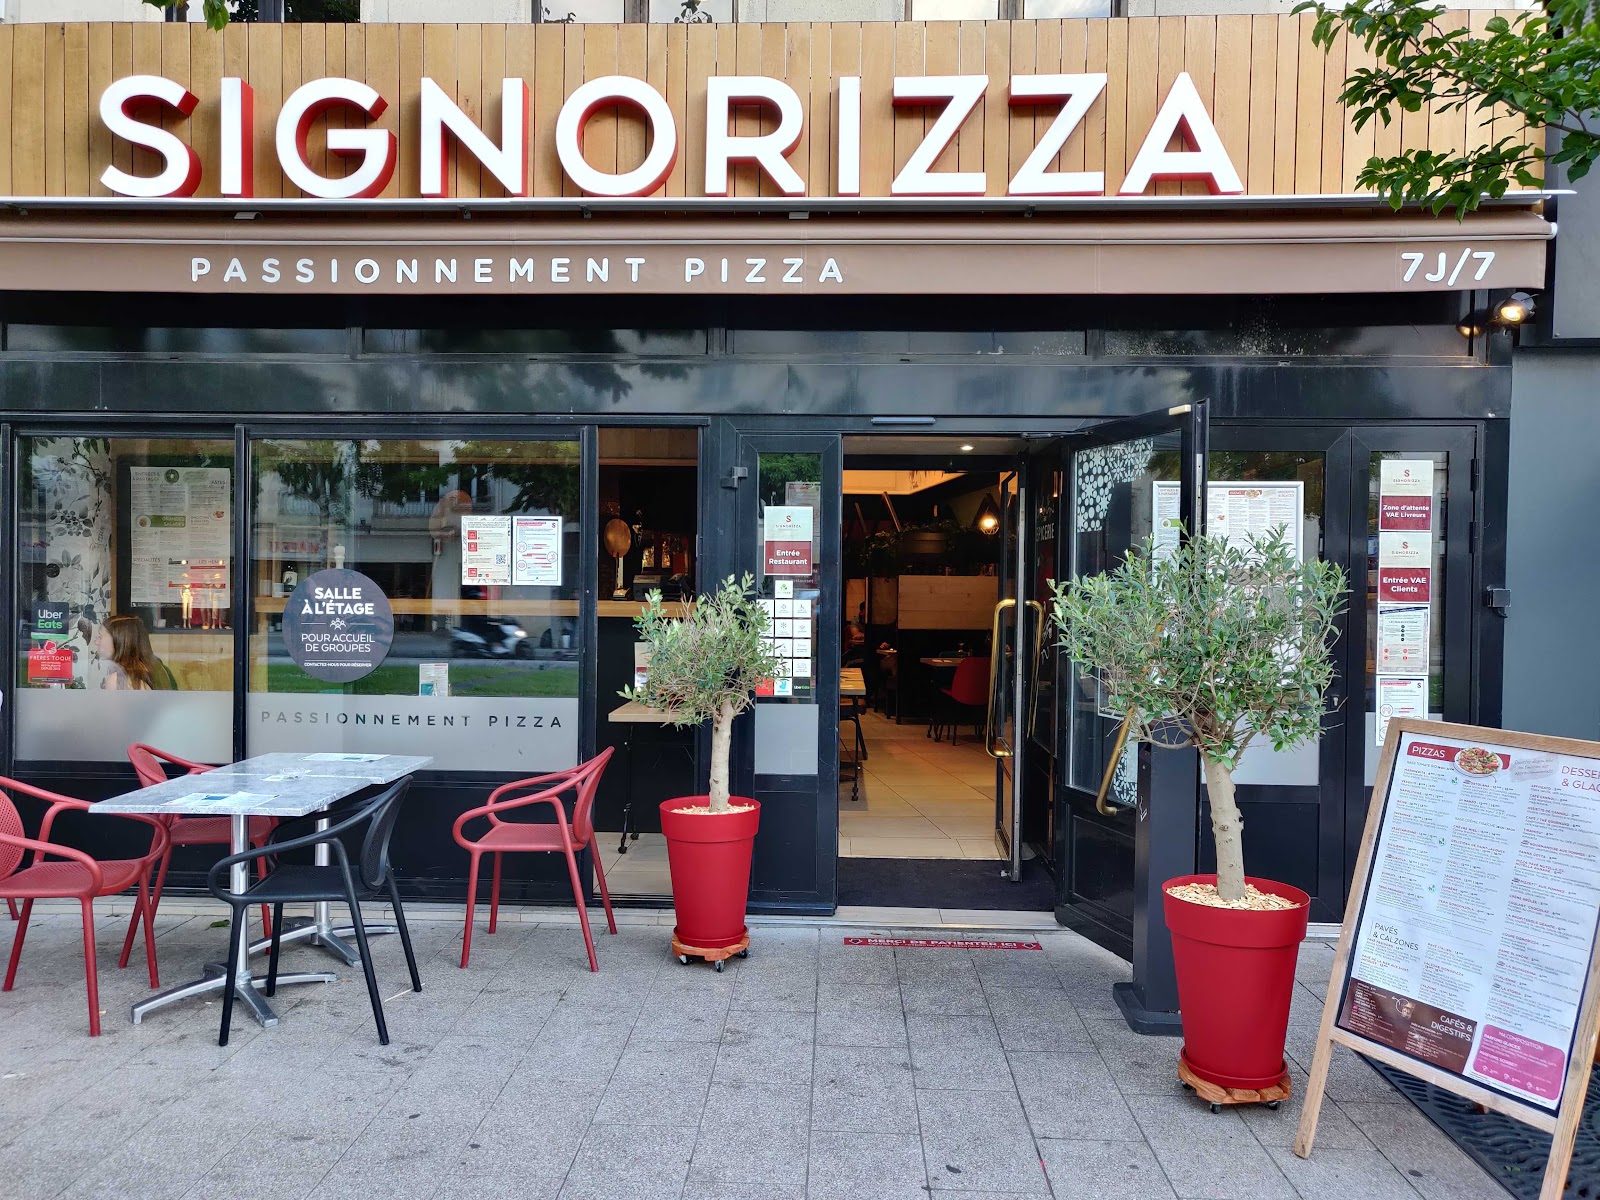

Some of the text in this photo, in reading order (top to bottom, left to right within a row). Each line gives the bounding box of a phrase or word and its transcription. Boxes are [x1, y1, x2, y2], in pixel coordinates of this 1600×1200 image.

[100, 72, 1244, 199] SIGNORIZZA
[190, 256, 844, 284] PASSIONNEMENT PIZZA
[1400, 248, 1497, 288] 7J/7
[776, 549, 800, 557] Entrée
[769, 558, 808, 566] Restaurant
[314, 587, 362, 600] SALLE
[1391, 585, 1418, 593] Clients
[301, 599, 374, 615] À L'ÉTAGE
[38, 609, 63, 619] Uber
[37, 620, 63, 629] Eats
[301, 633, 375, 643] POUR ACCUEIL
[305, 643, 371, 653] DE GROUPES
[261, 711, 562, 728] PASSIONNEMENT PIZZA
[1412, 745, 1445, 759] PIZZAS
[1561, 766, 1600, 781] DESSE
[1561, 778, 1570, 788] &
[1374, 921, 1399, 936] PAVÉS
[1372, 931, 1419, 951] & CALZONES
[1431, 1023, 1471, 1042] DIGESTIFS
[1466, 1025, 1473, 1033] &
